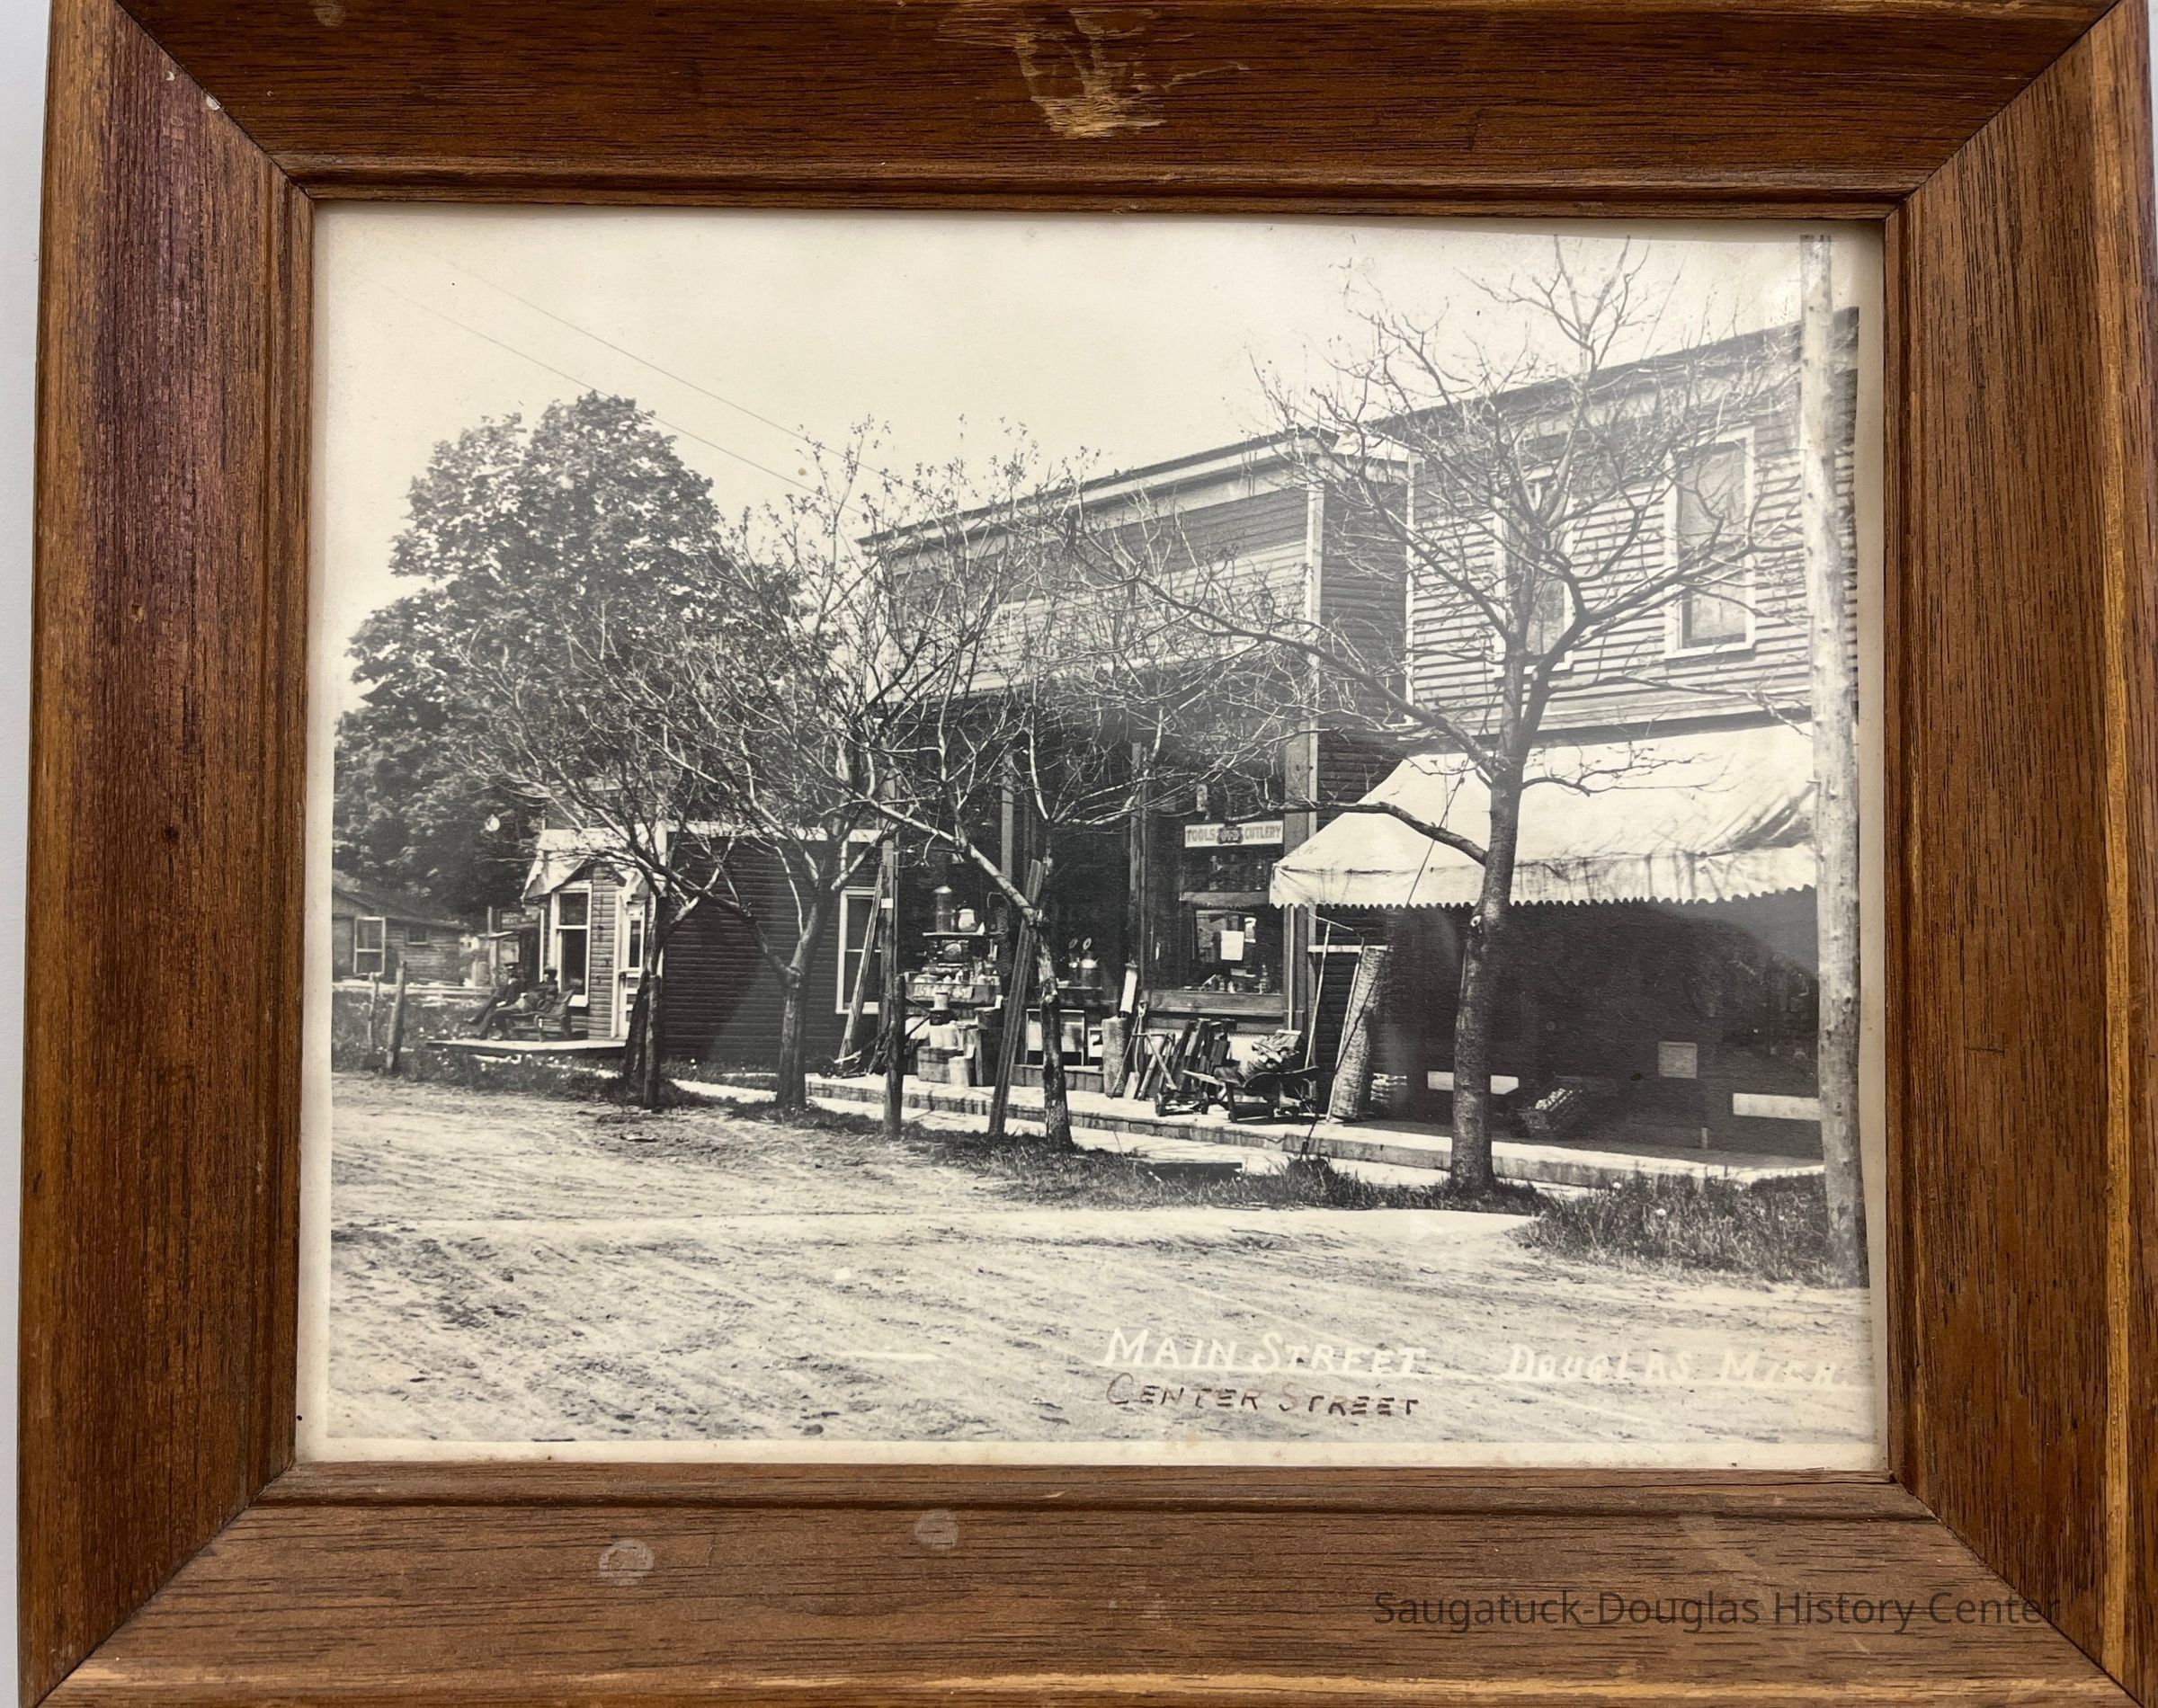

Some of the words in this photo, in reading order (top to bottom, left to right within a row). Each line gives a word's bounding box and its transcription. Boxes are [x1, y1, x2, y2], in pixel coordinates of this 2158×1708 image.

[1187, 828, 1215, 841] TOOLS
[1244, 825, 1280, 839] CUTLERY
[1104, 1328, 1238, 1367] MAIN
[1251, 1331, 1426, 1374] STREET
[1507, 1345, 1691, 1381] DOUGLAS
[1104, 1372, 1261, 1411] CENTER
[1278, 1383, 1420, 1418] STREET
